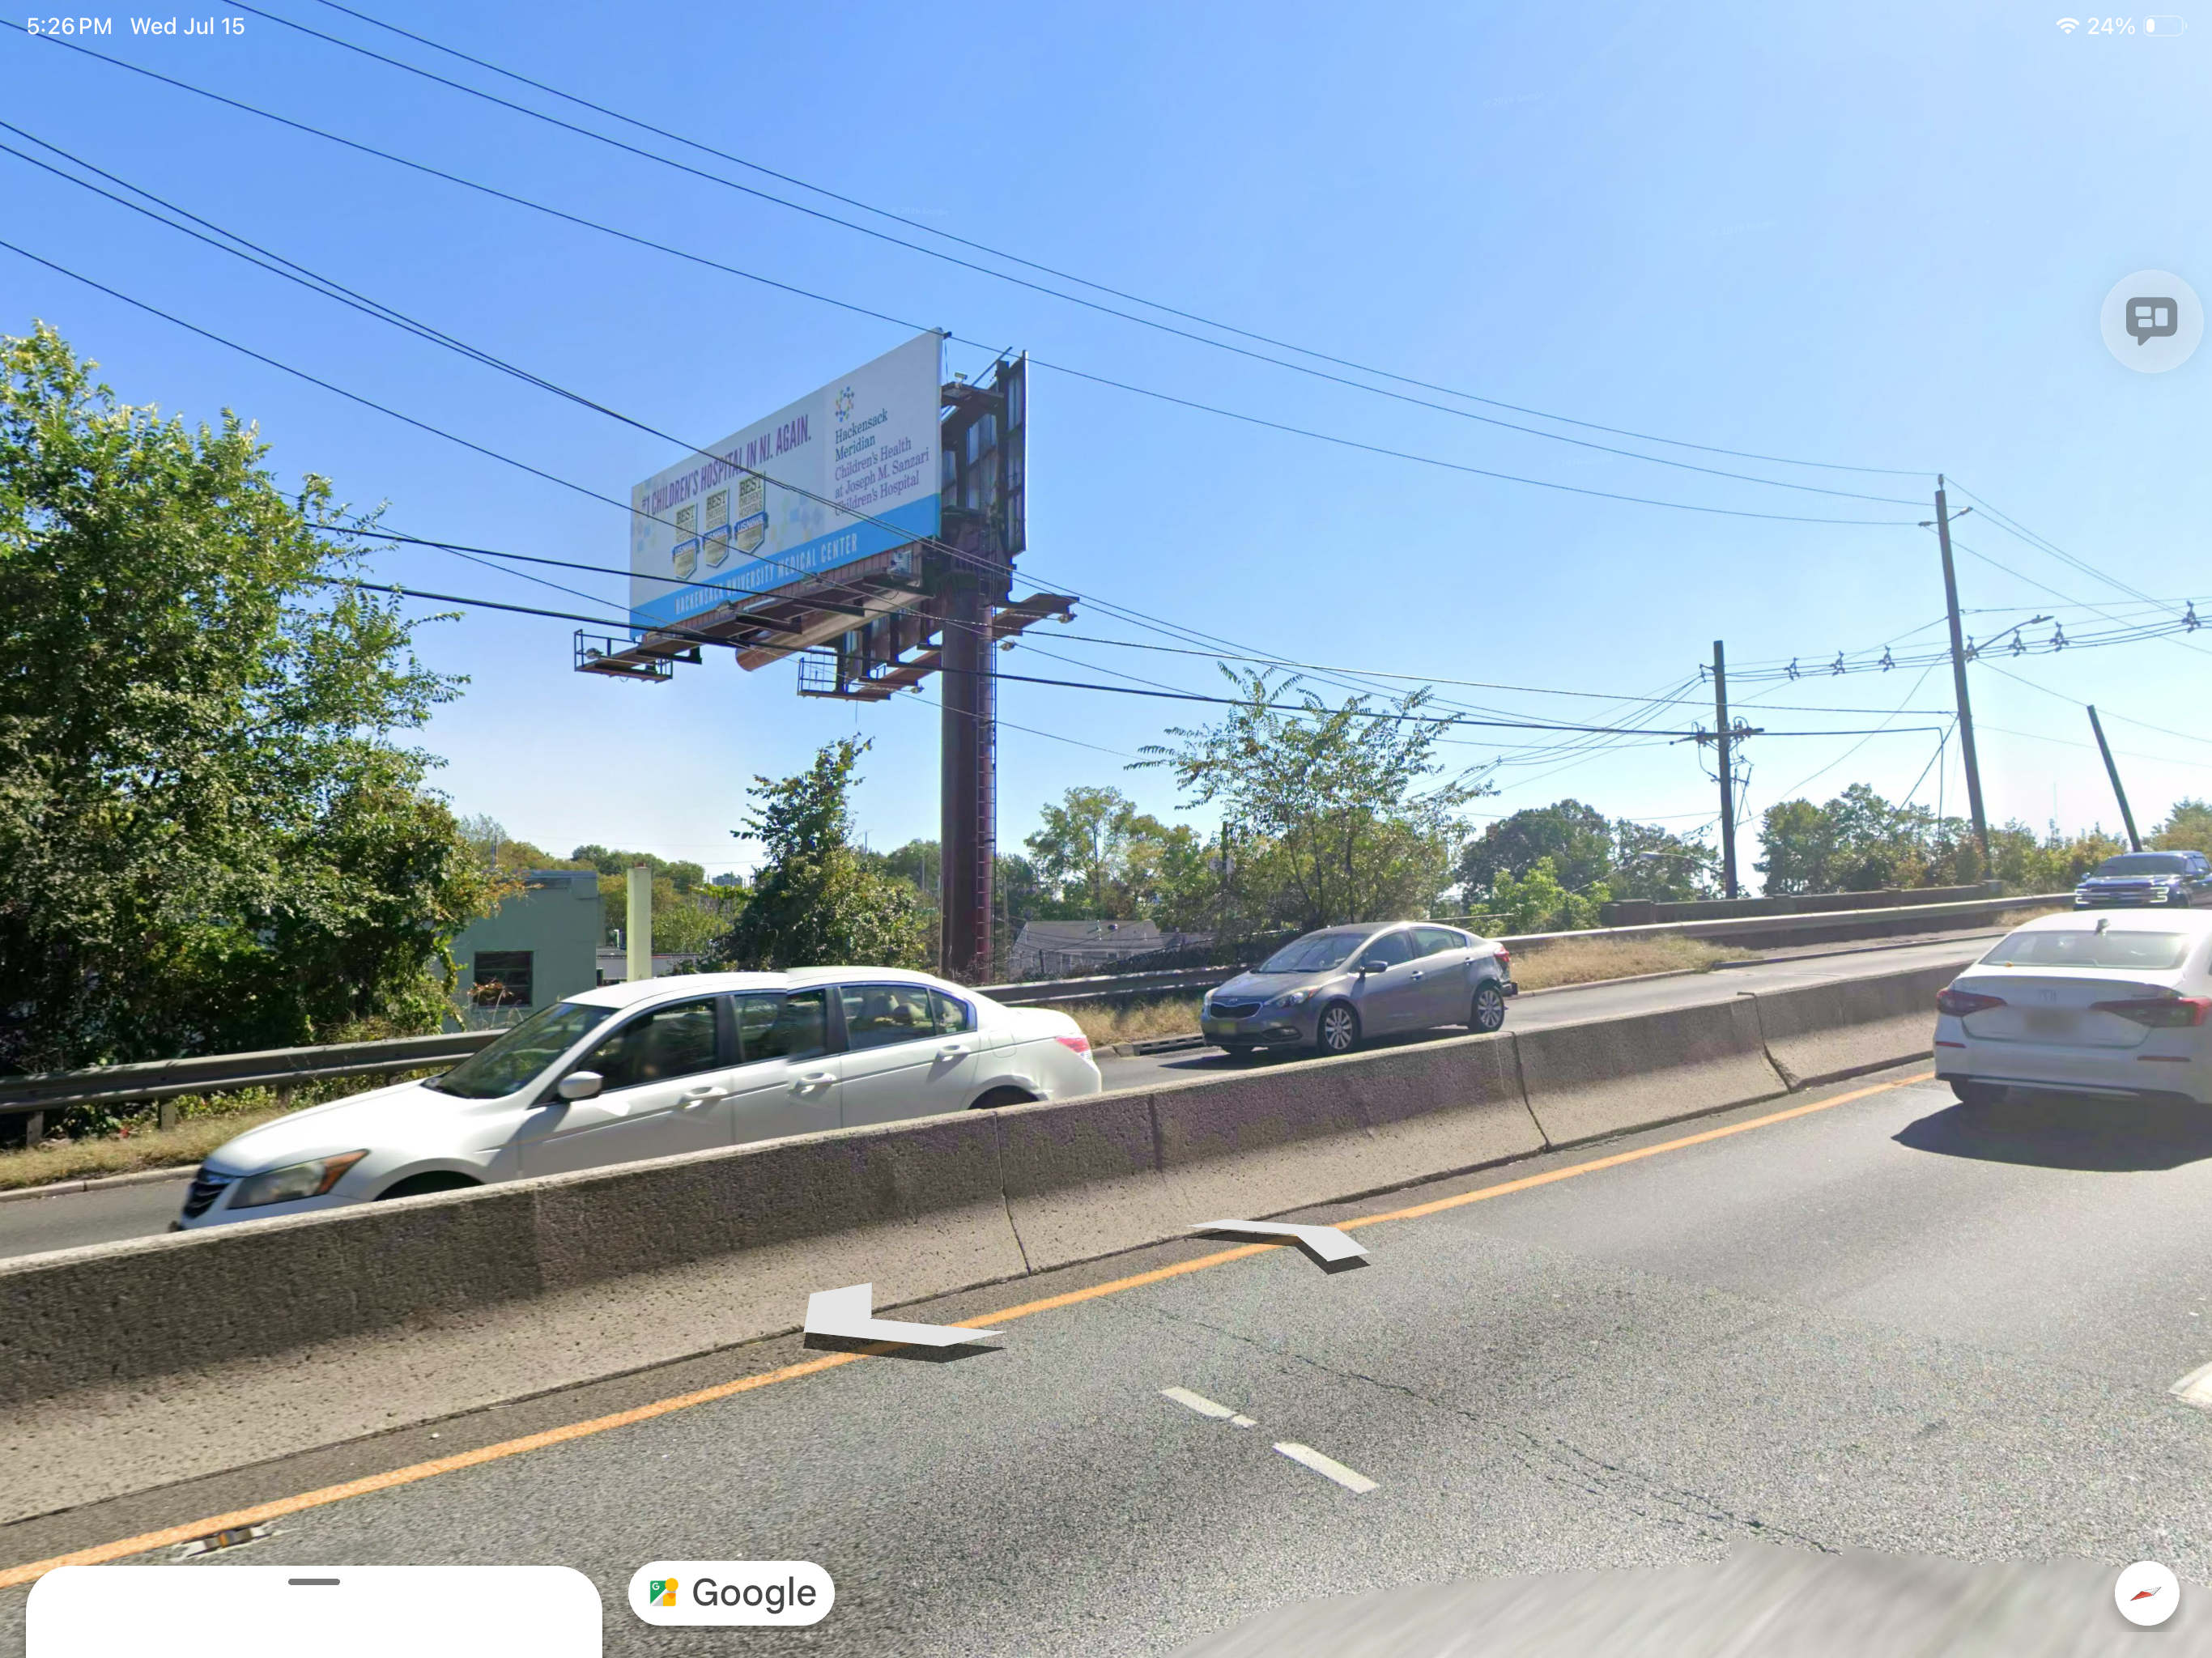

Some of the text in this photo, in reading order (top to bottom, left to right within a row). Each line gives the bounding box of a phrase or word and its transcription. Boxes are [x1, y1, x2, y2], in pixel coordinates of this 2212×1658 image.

[835, 408, 889, 444] Hackensack
[652, 470, 699, 517] CHILDREN'S
[700, 447, 744, 493] HOSPITAL
[747, 440, 757, 469] IN
[776, 414, 812, 457] AGAIN.
[835, 435, 876, 462] Meridian
[835, 436, 912, 482] Children's Health
[739, 474, 763, 497] BEST
[835, 446, 930, 500] at Joseph M. Sanzari
[835, 470, 920, 517] Children's Hospital
[676, 504, 696, 525] BEST
[707, 490, 728, 511] BEST
[674, 584, 725, 615] HACKENSACK
[726, 564, 774, 596] UNIVERSITY
[777, 551, 816, 579] MEDICAL
[821, 533, 858, 563] CENTER
